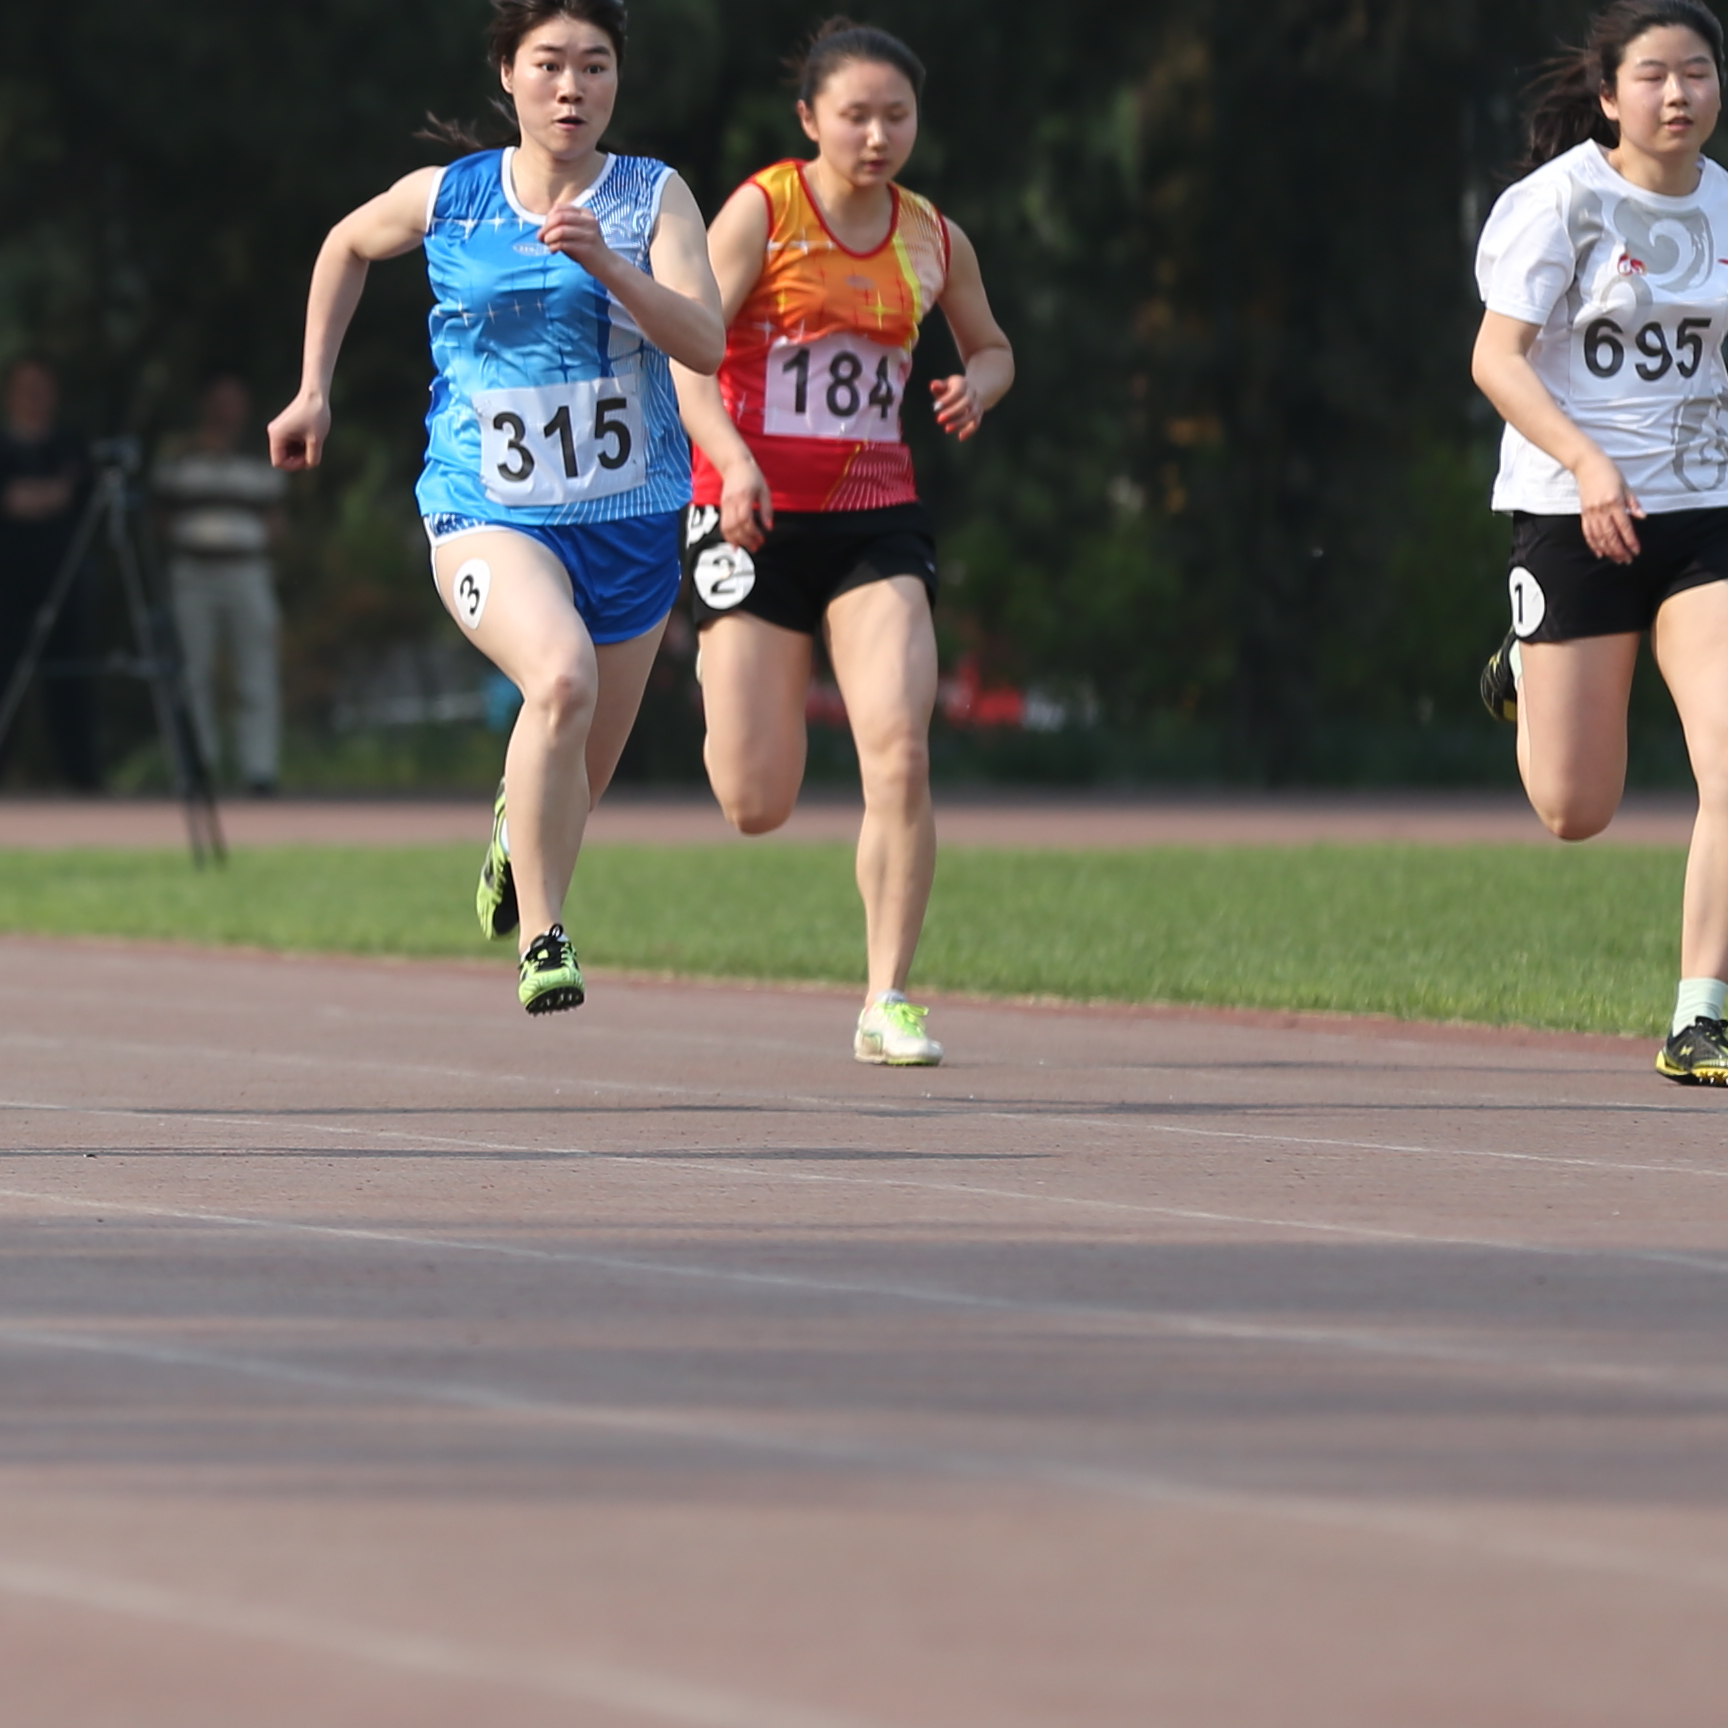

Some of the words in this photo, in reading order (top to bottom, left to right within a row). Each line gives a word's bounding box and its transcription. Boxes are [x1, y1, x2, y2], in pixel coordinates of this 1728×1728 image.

[1584, 317, 1712, 382] 695
[782, 348, 894, 419] 184
[493, 396, 632, 483] 315
[460, 574, 480, 616] 3
[710, 555, 736, 596] 2
[1515, 581, 1523, 624] 1
